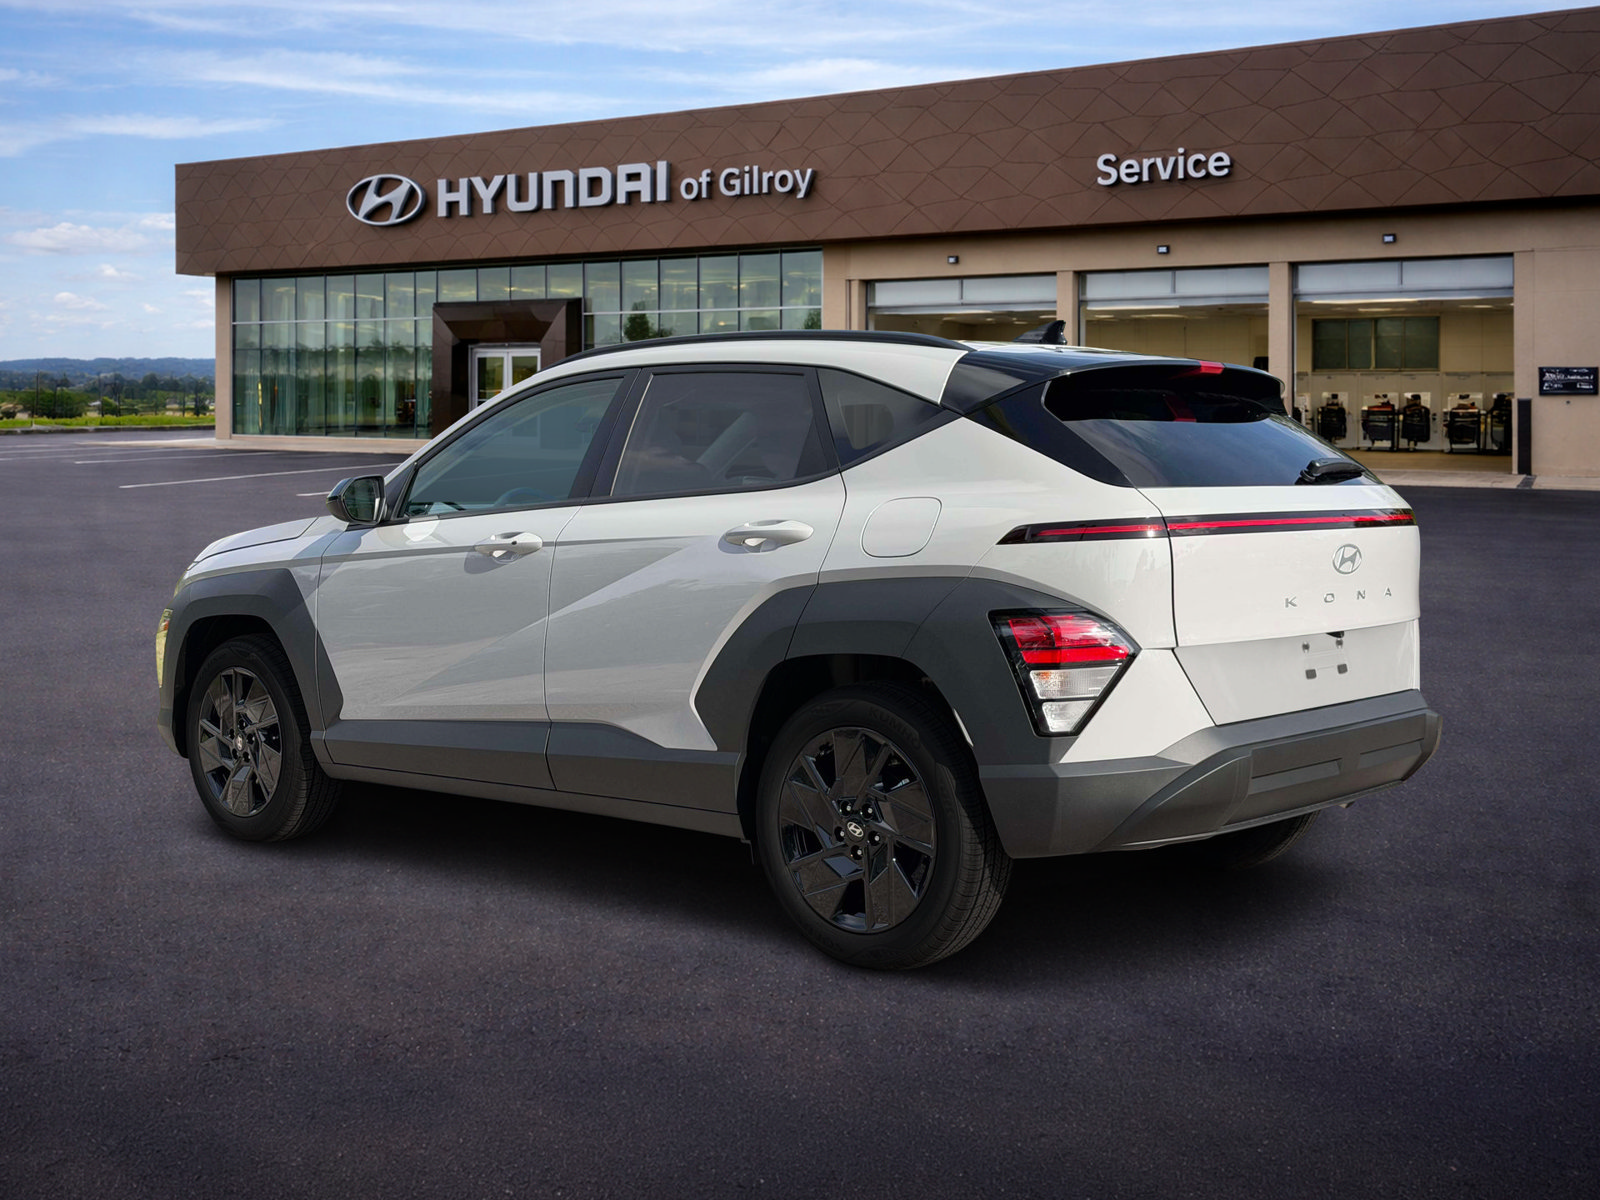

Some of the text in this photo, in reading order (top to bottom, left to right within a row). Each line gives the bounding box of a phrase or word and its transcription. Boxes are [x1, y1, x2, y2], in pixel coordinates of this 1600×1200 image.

[1096, 147, 1232, 187] Service
[437, 160, 814, 218] HYUNDAI of Gilroy
[1285, 587, 1392, 608] KONA
